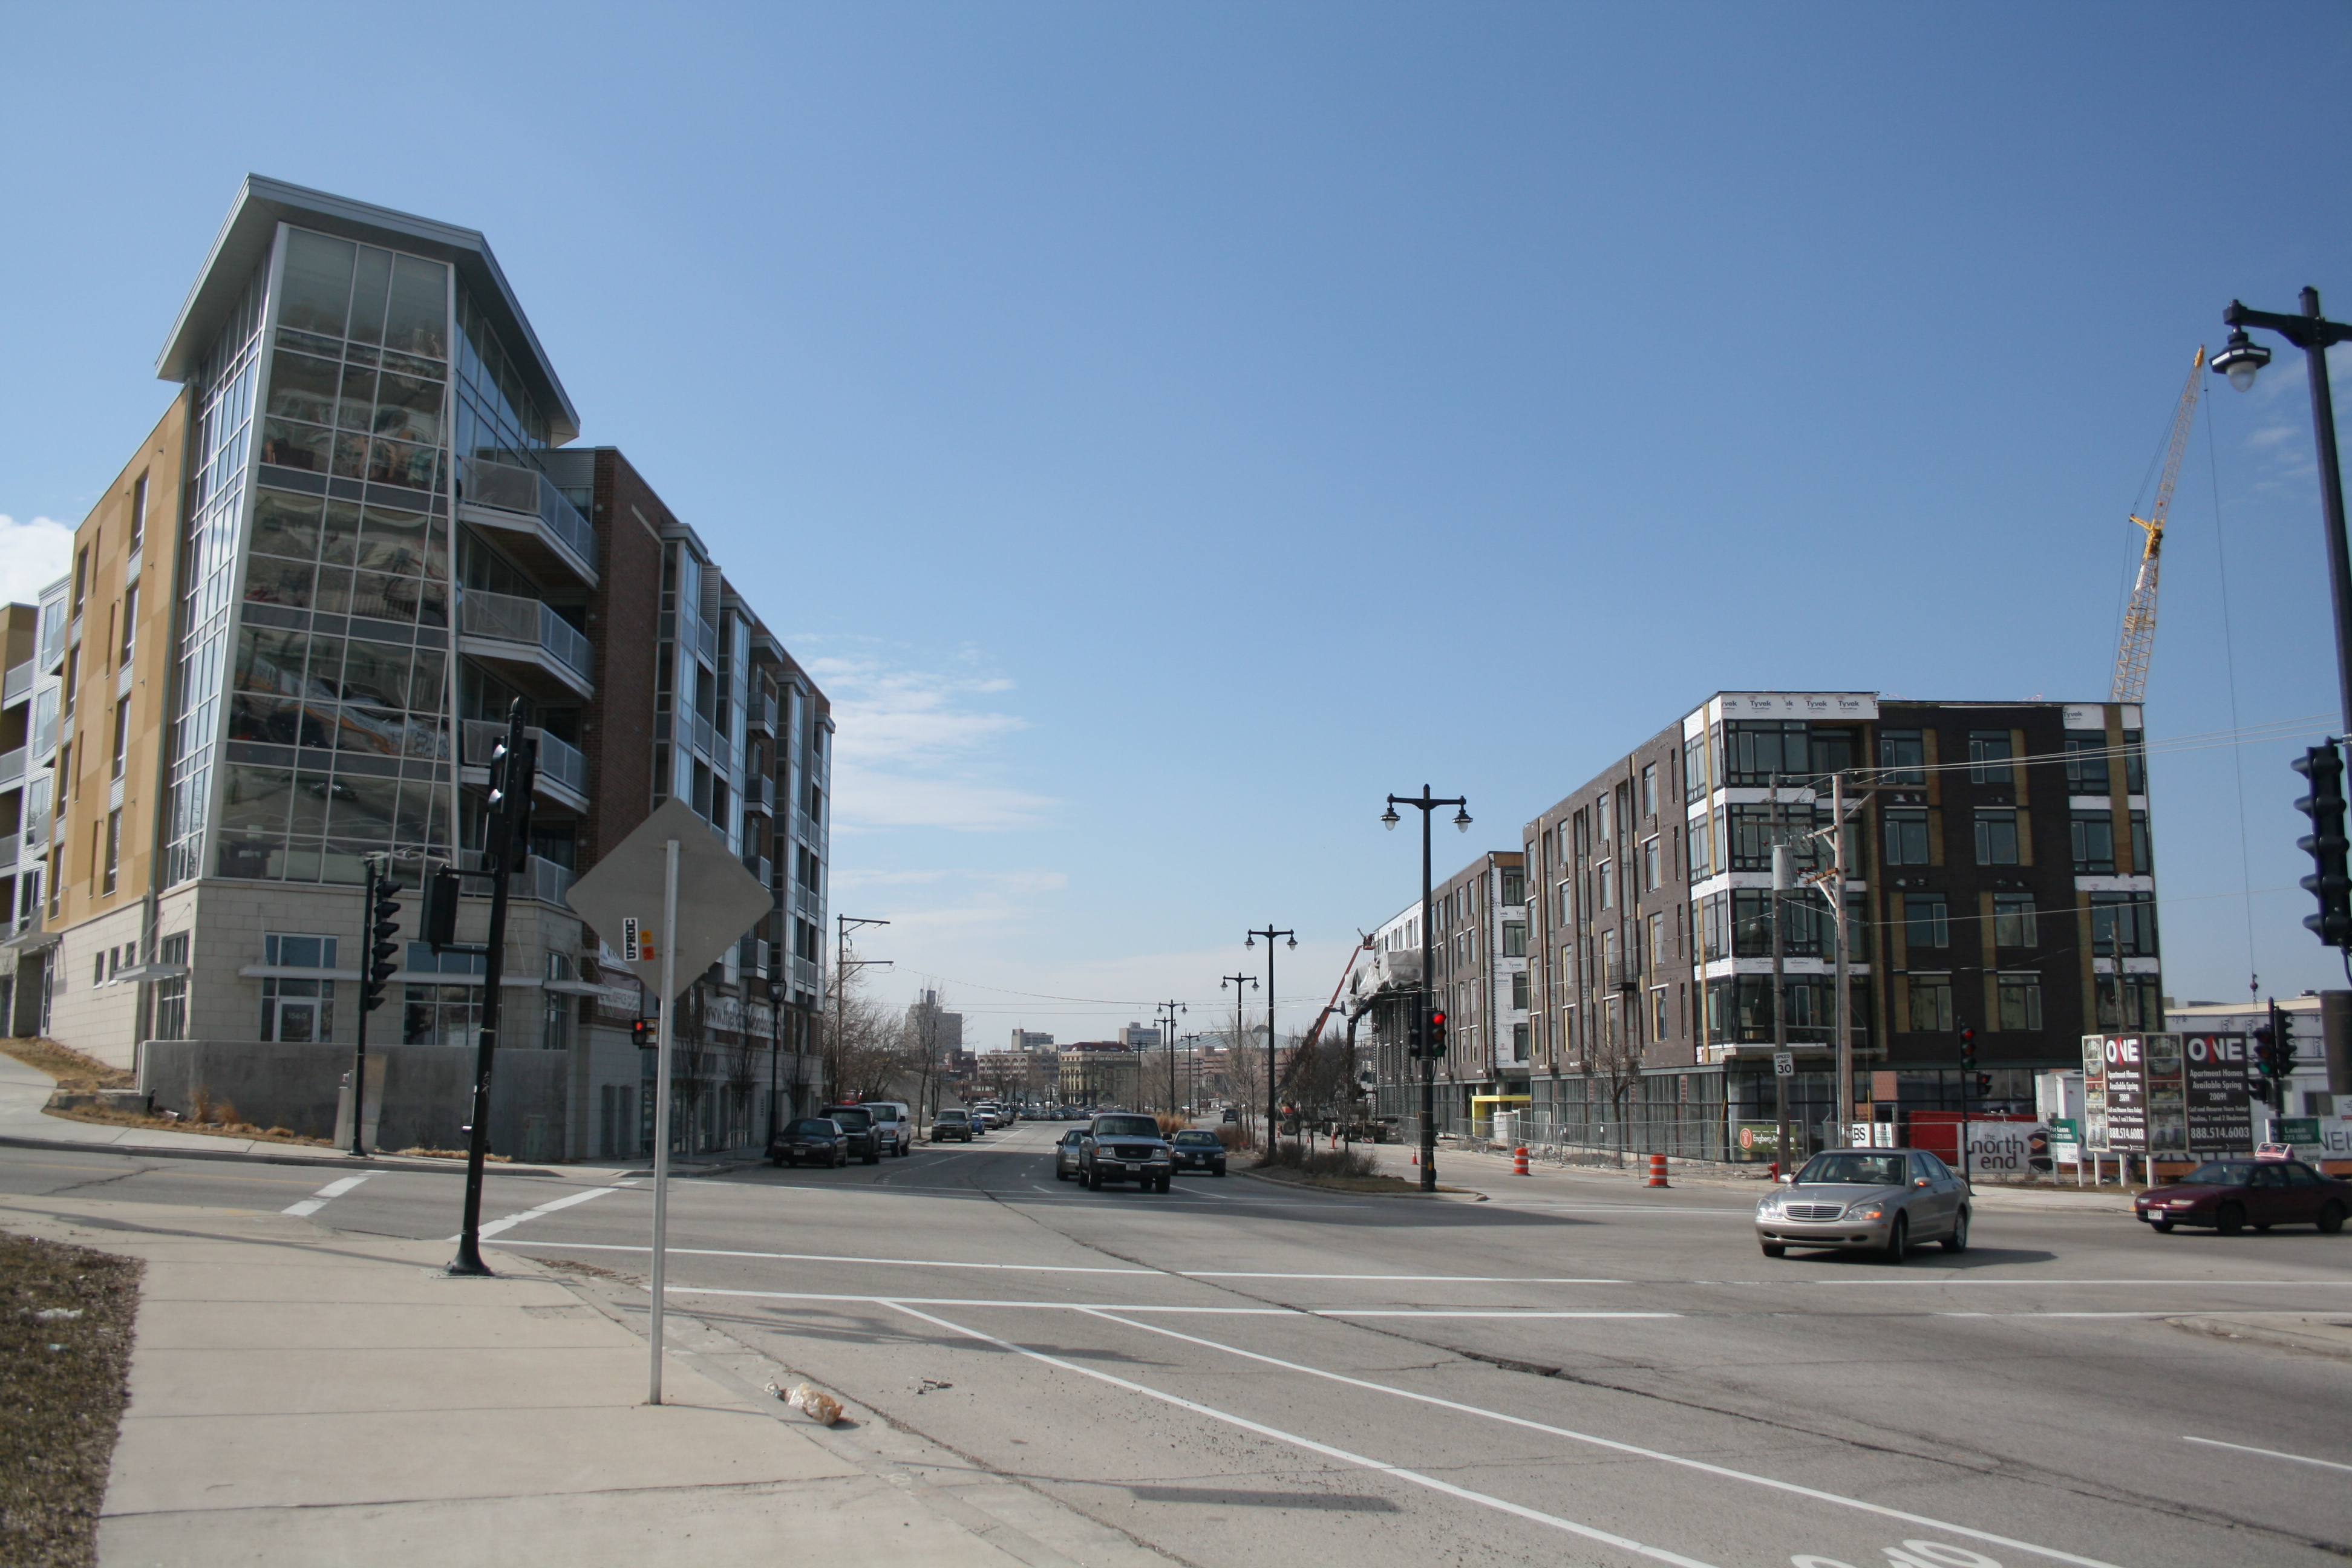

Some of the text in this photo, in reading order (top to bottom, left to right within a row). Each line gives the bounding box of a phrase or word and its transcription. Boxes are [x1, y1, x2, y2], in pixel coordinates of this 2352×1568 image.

[626, 919, 636, 960] UPROC
[2106, 1039, 2139, 1063] ONE
[2187, 1038, 2243, 1061] ONE
[1777, 1064, 1792, 1074] 30
[2189, 1069, 2221, 1078] Apartment
[2108, 1071, 2126, 1080] Apartment
[2126, 1082, 2138, 1091] Spring
[2222, 1080, 2241, 1090] Spring
[2109, 1128, 2143, 1140] 888.514.6003
[2190, 1126, 2250, 1139] 888.514.6003
[1753, 1134, 1772, 1144] Engberg
[1971, 1134, 2024, 1154] north
[1981, 1151, 2016, 1169] end
